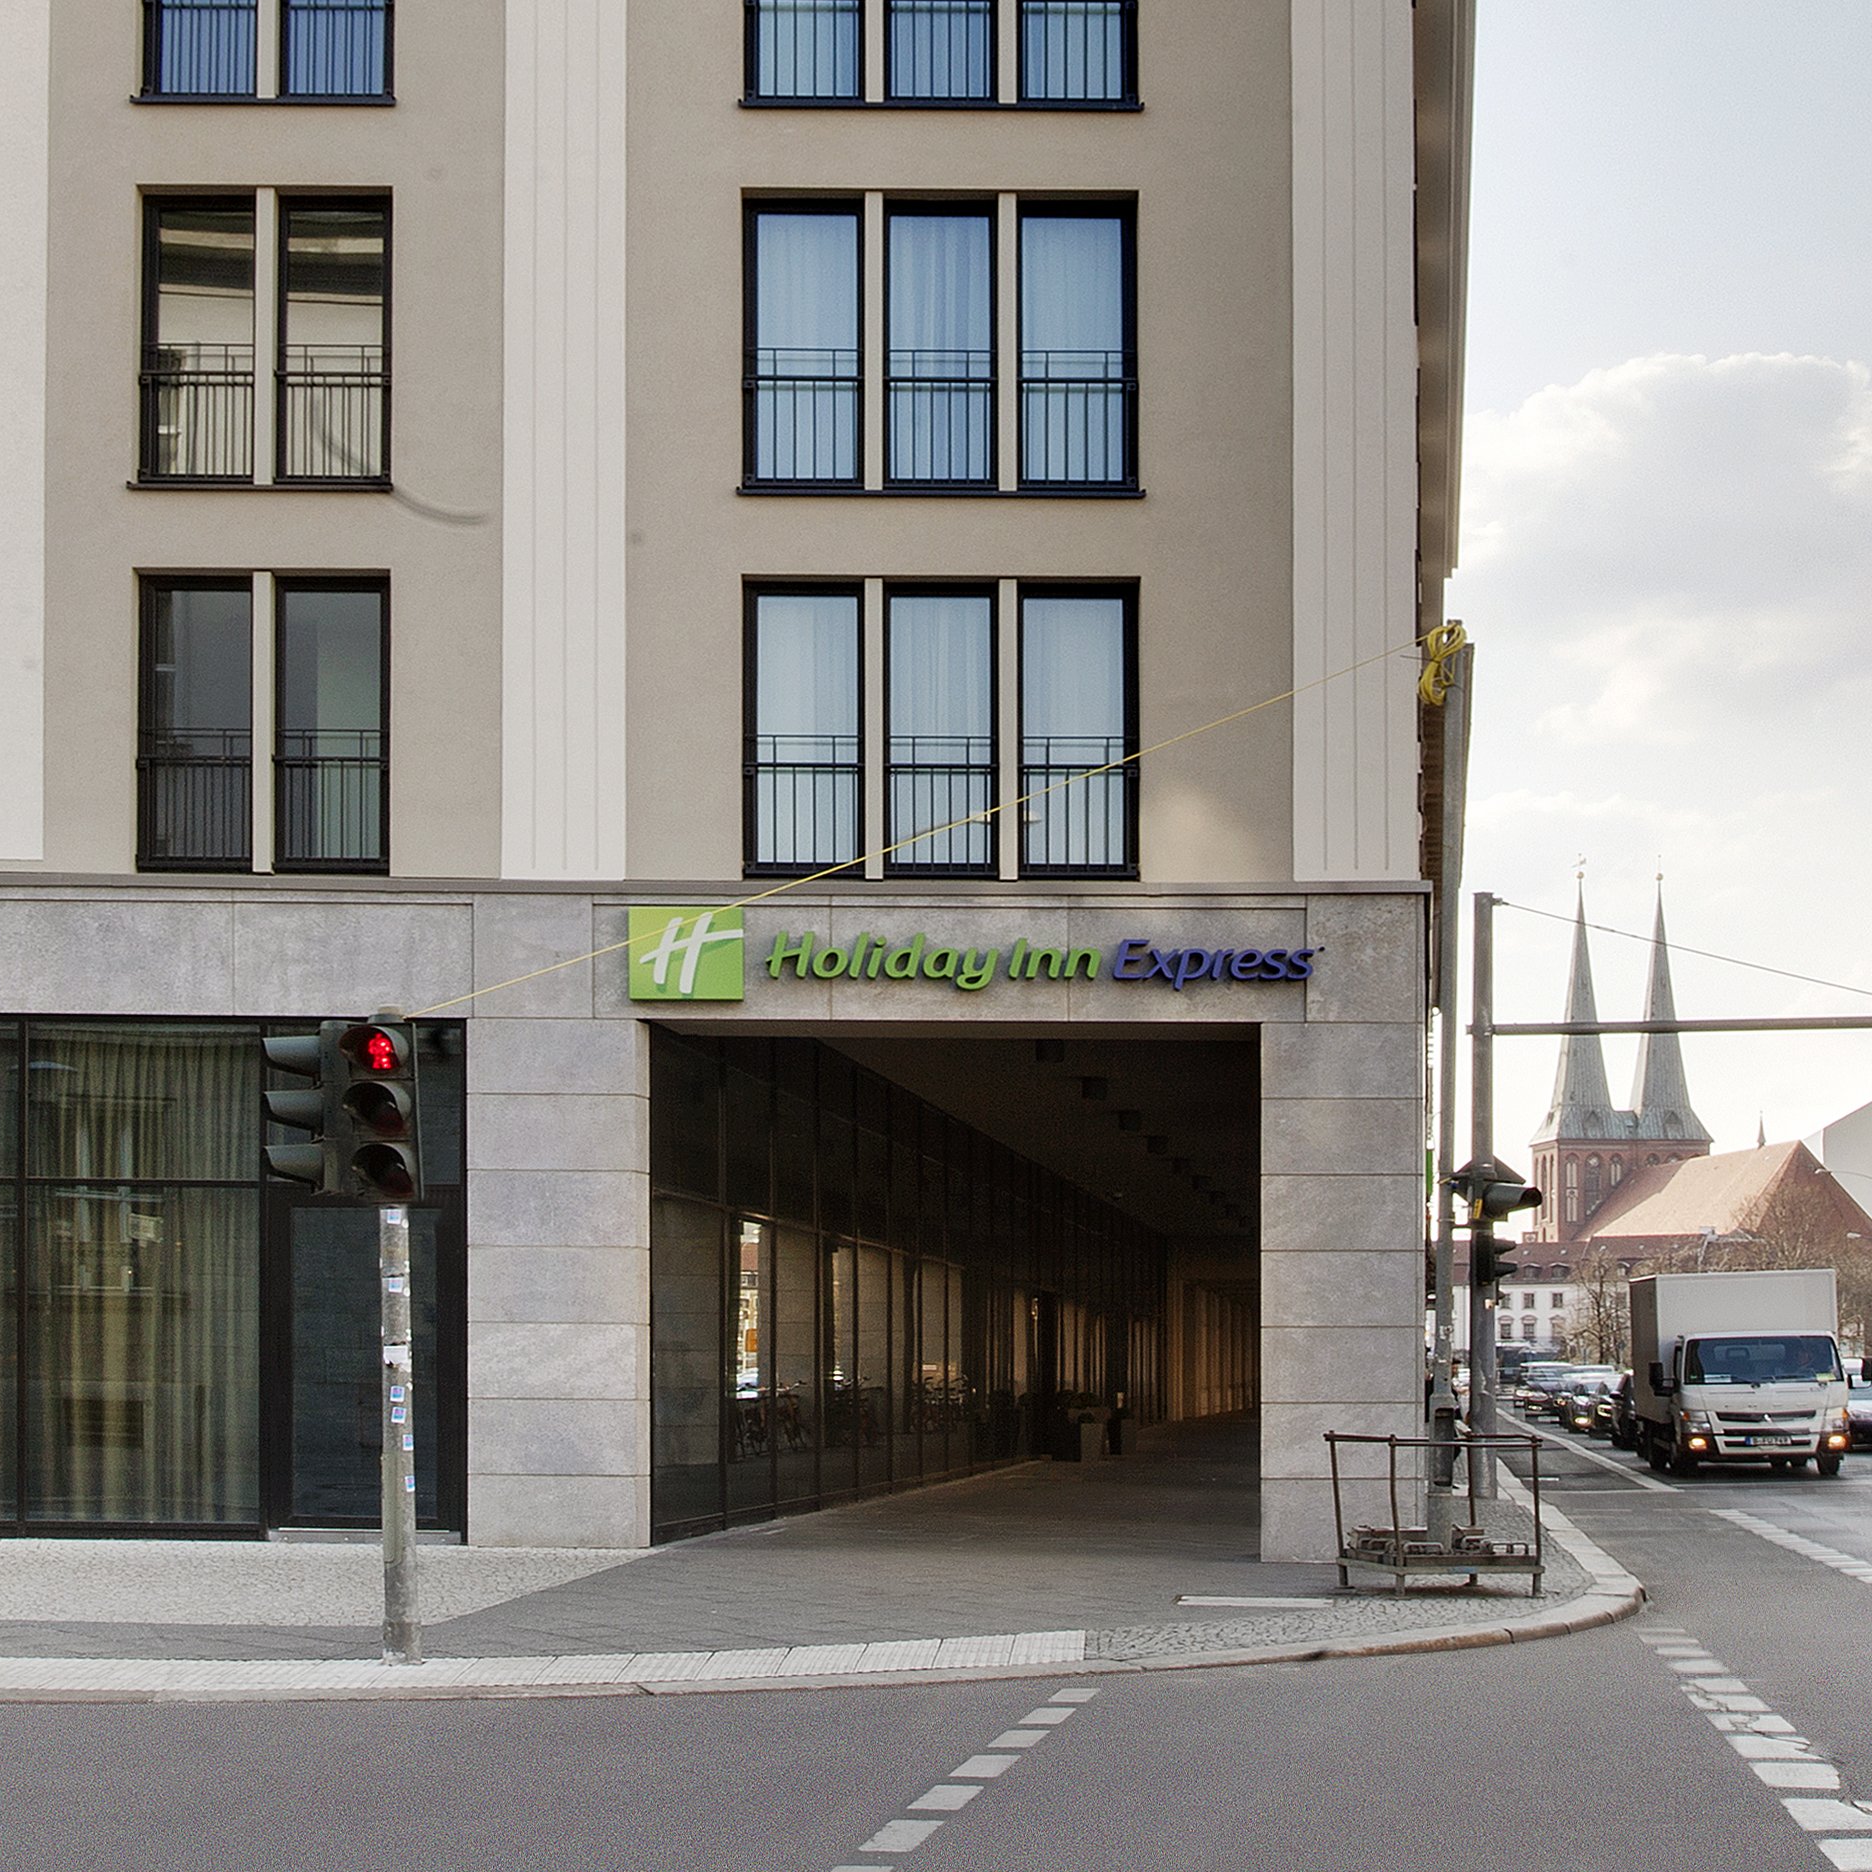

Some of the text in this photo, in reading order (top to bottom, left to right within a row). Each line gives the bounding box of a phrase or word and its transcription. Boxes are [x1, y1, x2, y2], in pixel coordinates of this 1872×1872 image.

[765, 931, 1316, 991] Holiday Inn Express
